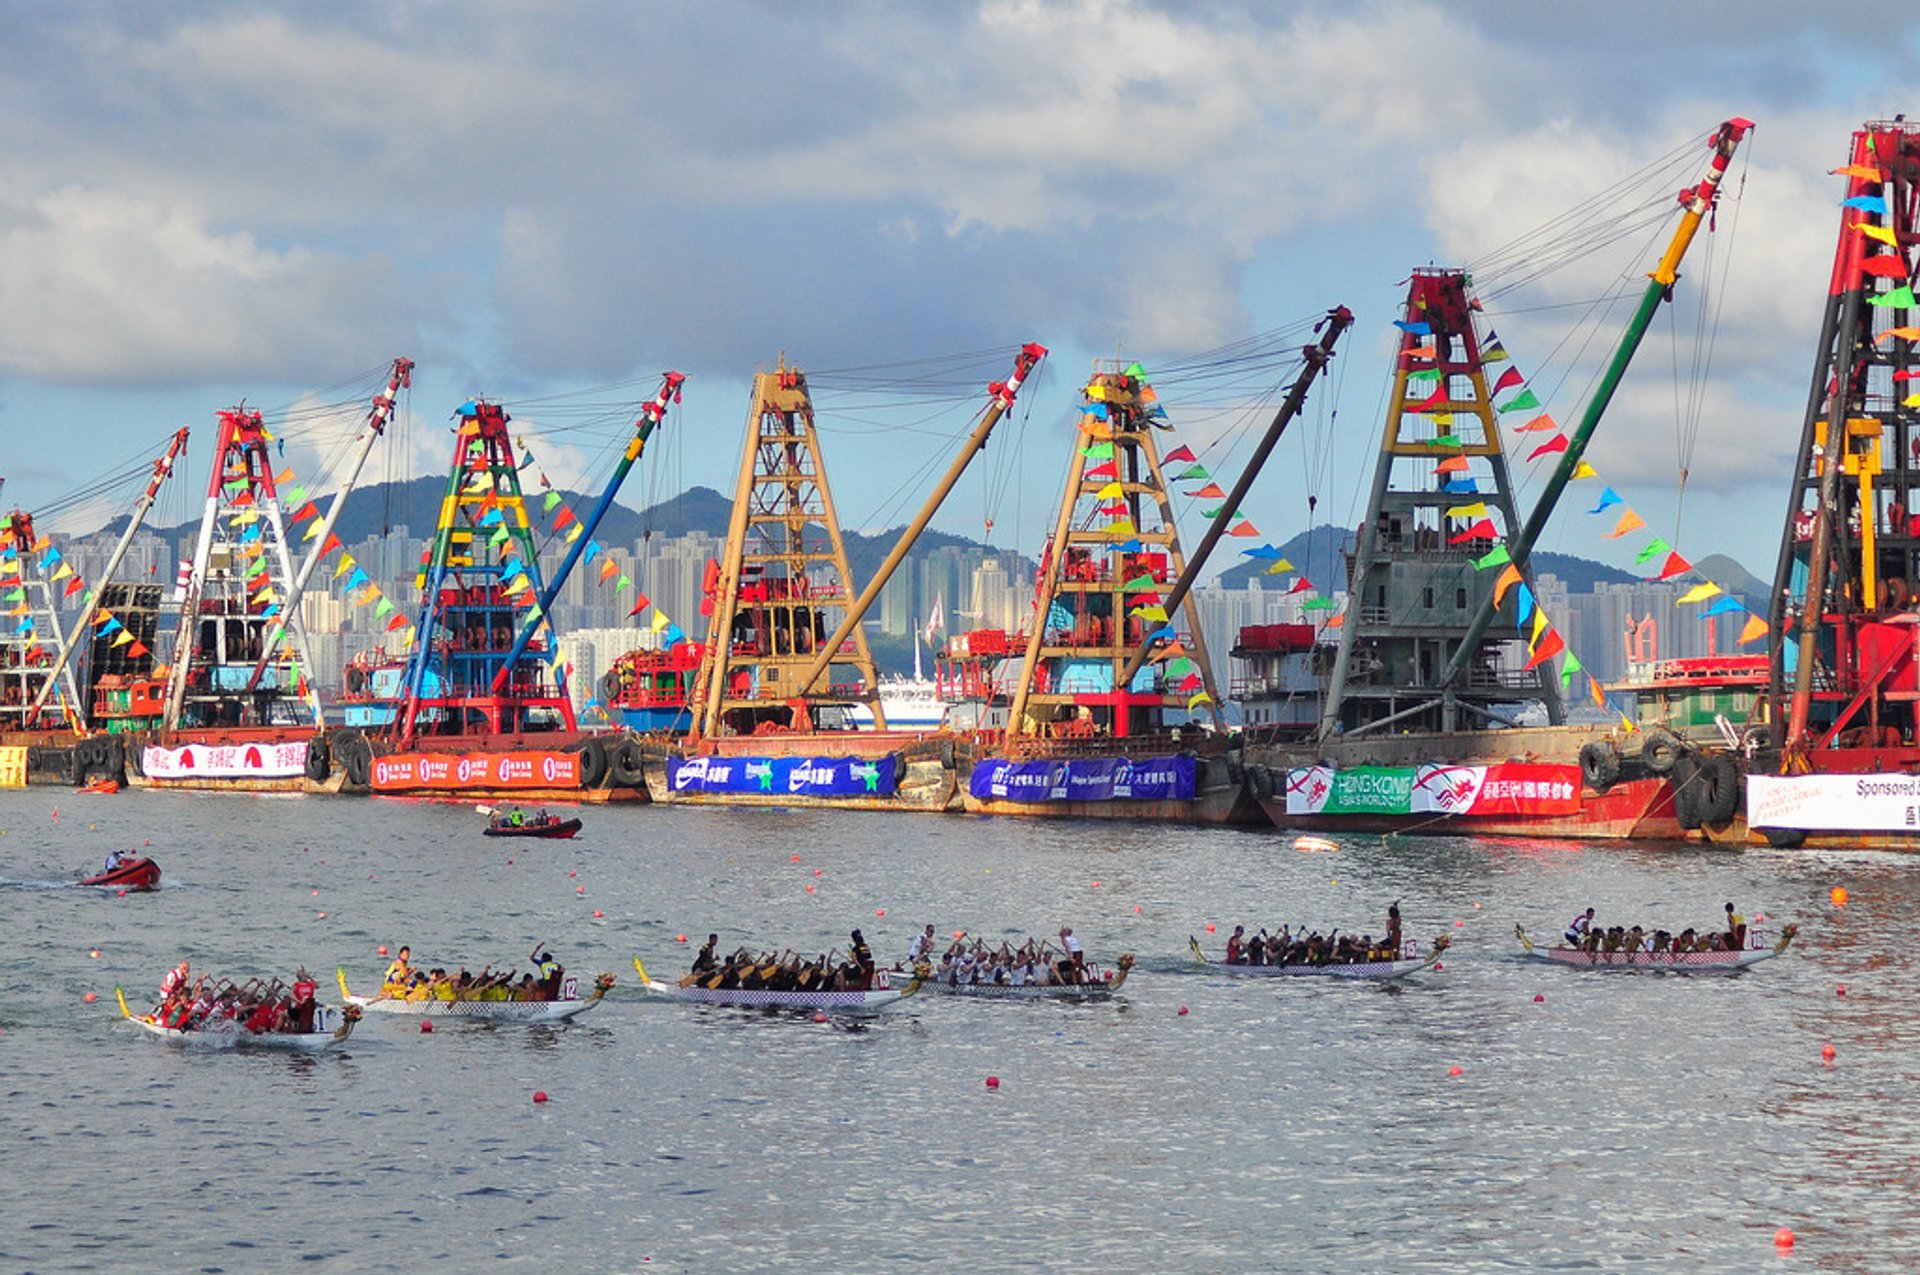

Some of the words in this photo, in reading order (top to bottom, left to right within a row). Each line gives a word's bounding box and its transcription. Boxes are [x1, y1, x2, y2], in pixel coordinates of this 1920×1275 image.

[1338, 774, 1371, 793] HONG
[1371, 775, 1411, 795] KONG
[1856, 779, 1916, 799] Sponsored
